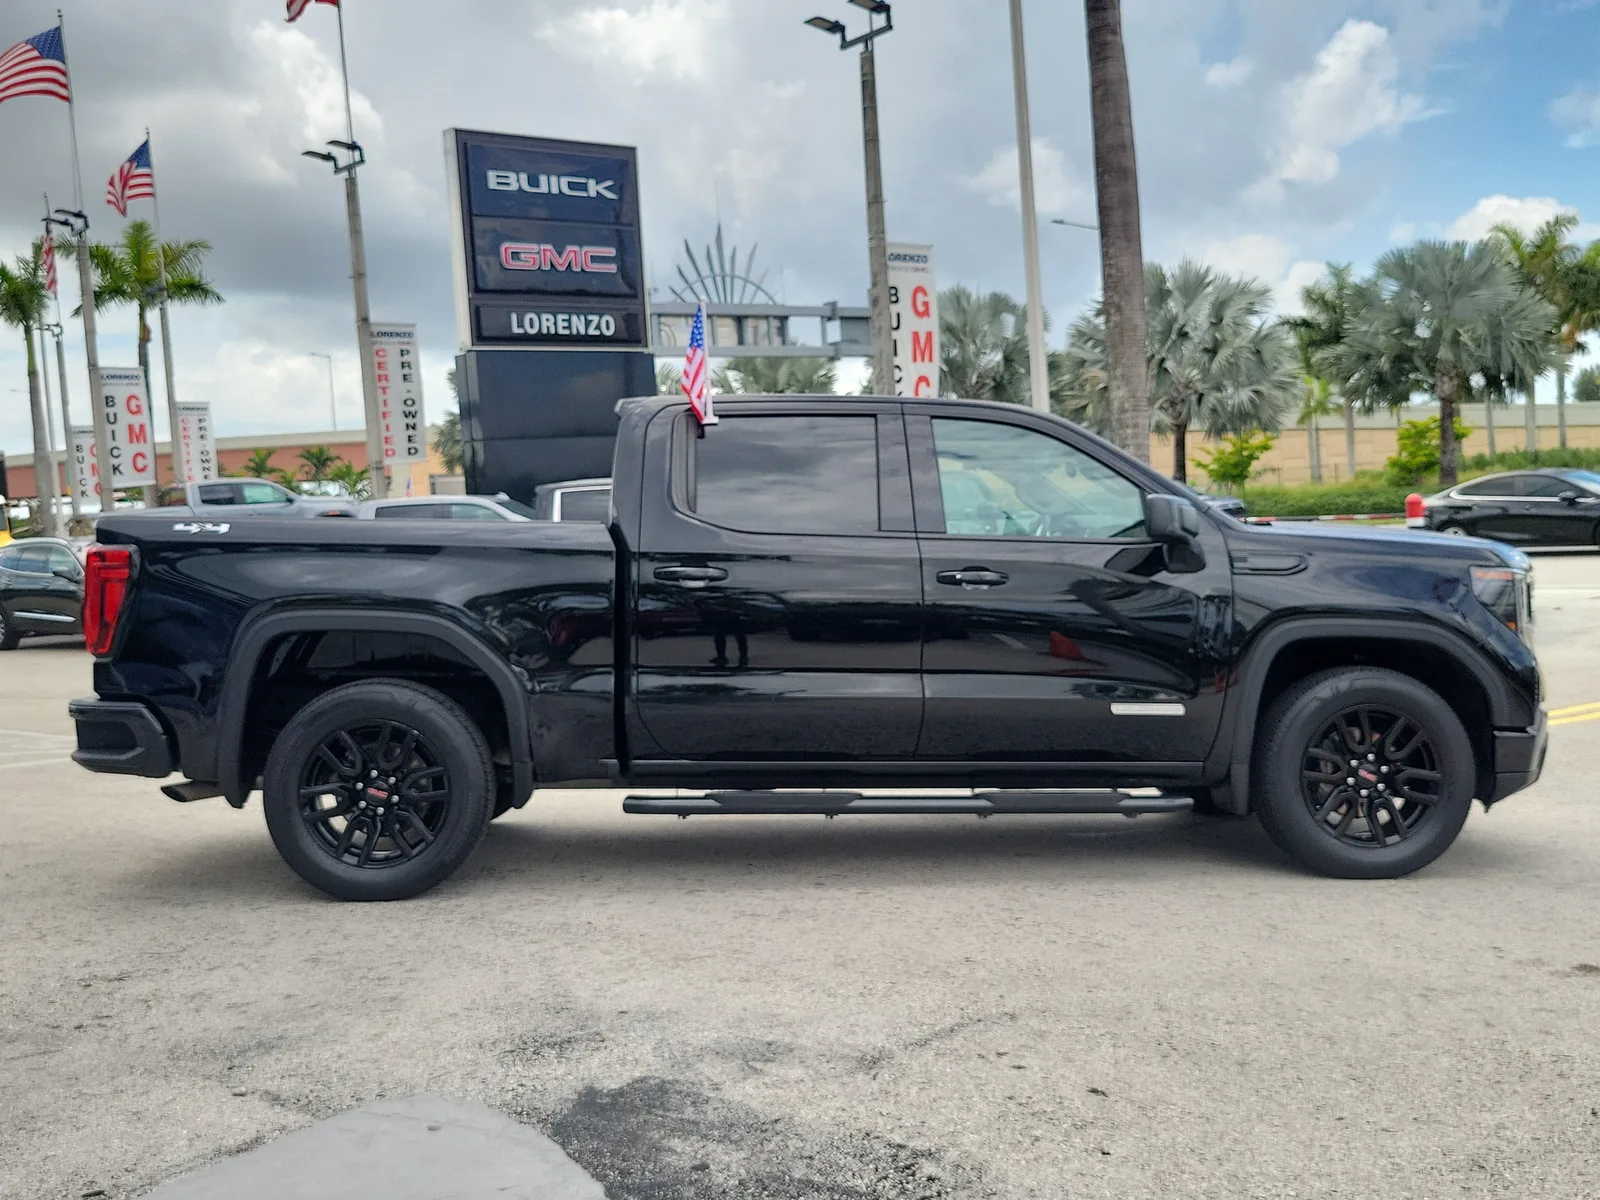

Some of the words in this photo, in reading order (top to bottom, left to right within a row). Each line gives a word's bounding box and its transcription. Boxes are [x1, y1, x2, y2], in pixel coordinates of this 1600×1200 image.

[486, 169, 618, 200] BUICK
[500, 242, 617, 273] GMC
[887, 252, 929, 264] ORENZO
[371, 331, 414, 339] LORENZO
[510, 312, 616, 336] LORENZO
[888, 286, 903, 397] BUIC
[911, 285, 933, 398] GMC
[125, 393, 149, 474] GMC
[375, 348, 396, 458] CERTIFIED
[400, 349, 418, 457] PRE-OWNED
[105, 395, 124, 476] BUICK
[180, 417, 195, 482] CERTIFIE
[198, 417, 212, 481] PRE-OWNE
[75, 444, 89, 499] BUICK
